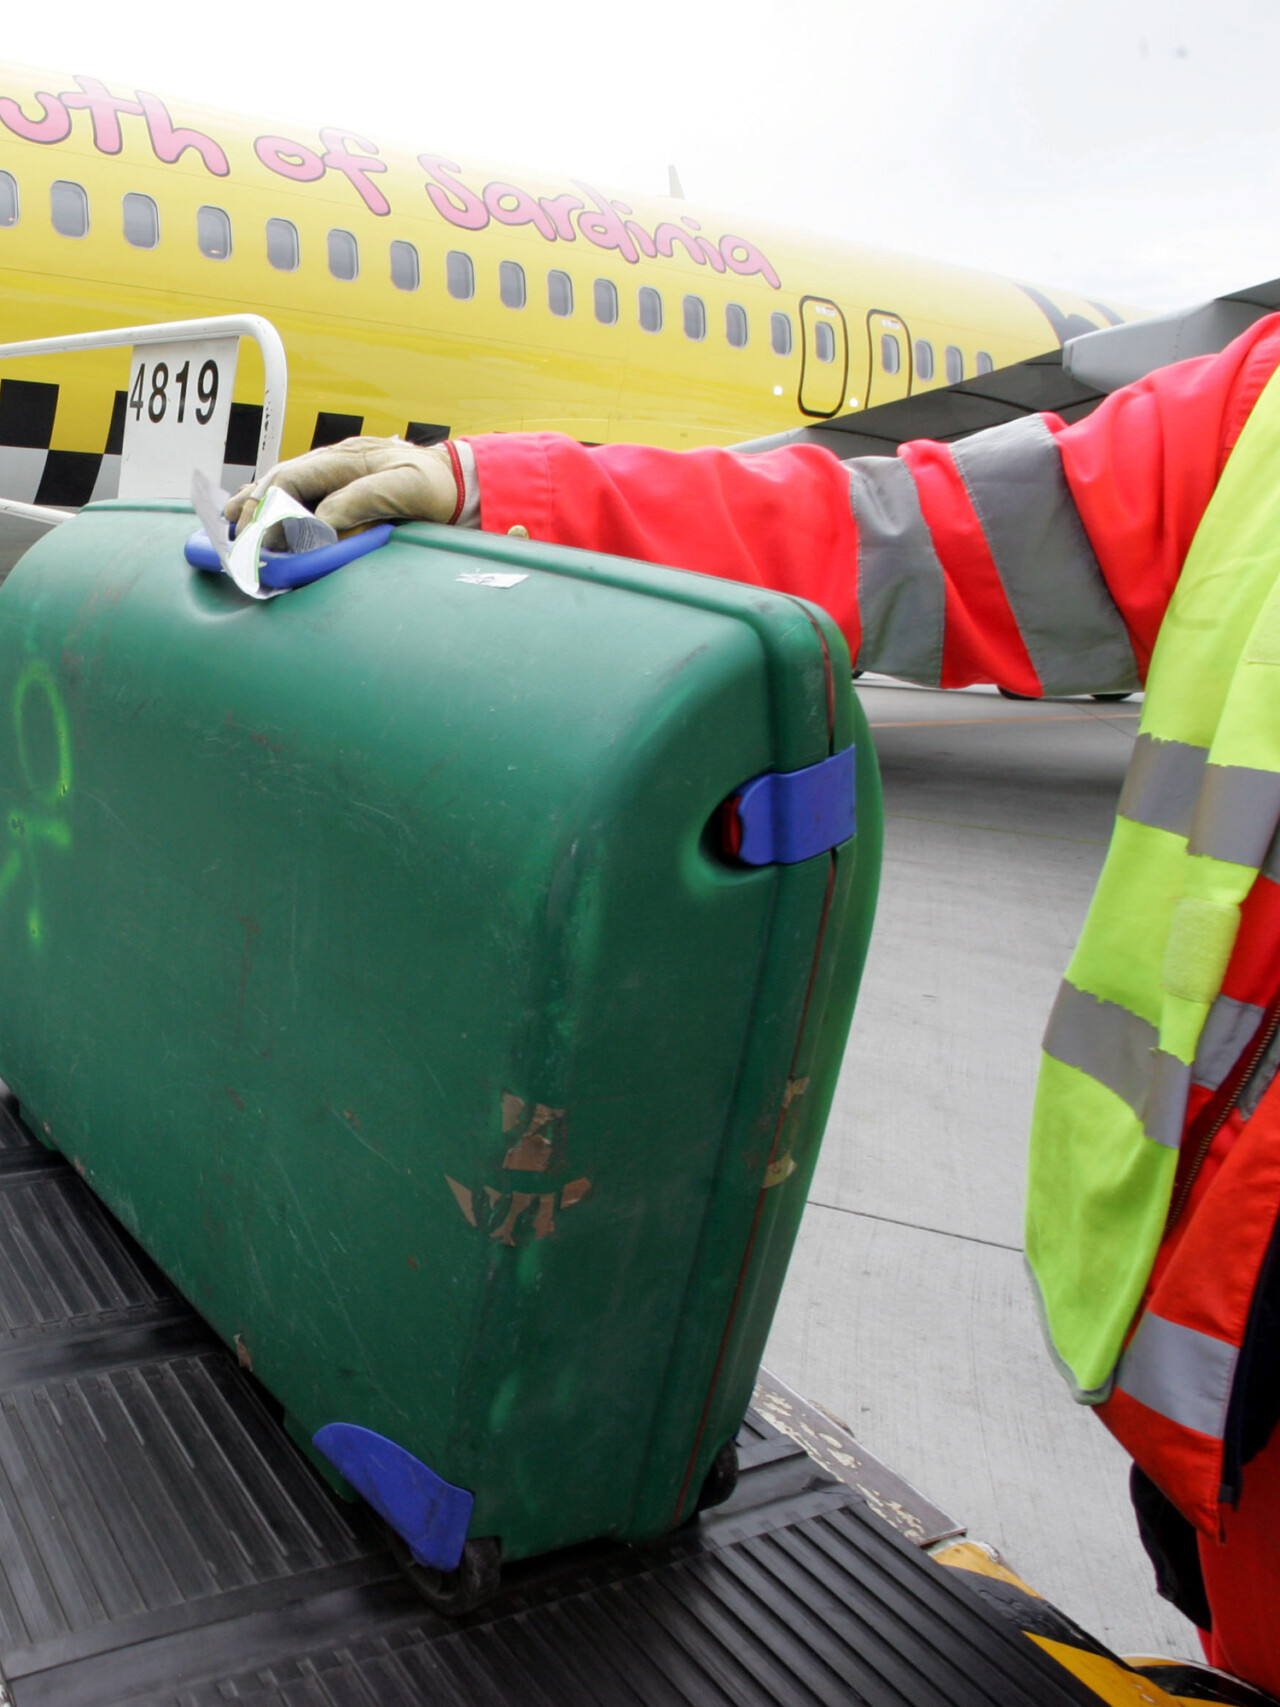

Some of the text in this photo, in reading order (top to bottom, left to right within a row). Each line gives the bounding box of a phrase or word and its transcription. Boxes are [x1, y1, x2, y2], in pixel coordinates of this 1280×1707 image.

[253, 127, 392, 217] of
[416, 152, 783, 290] Sardinia
[129, 359, 219, 425] 4819
